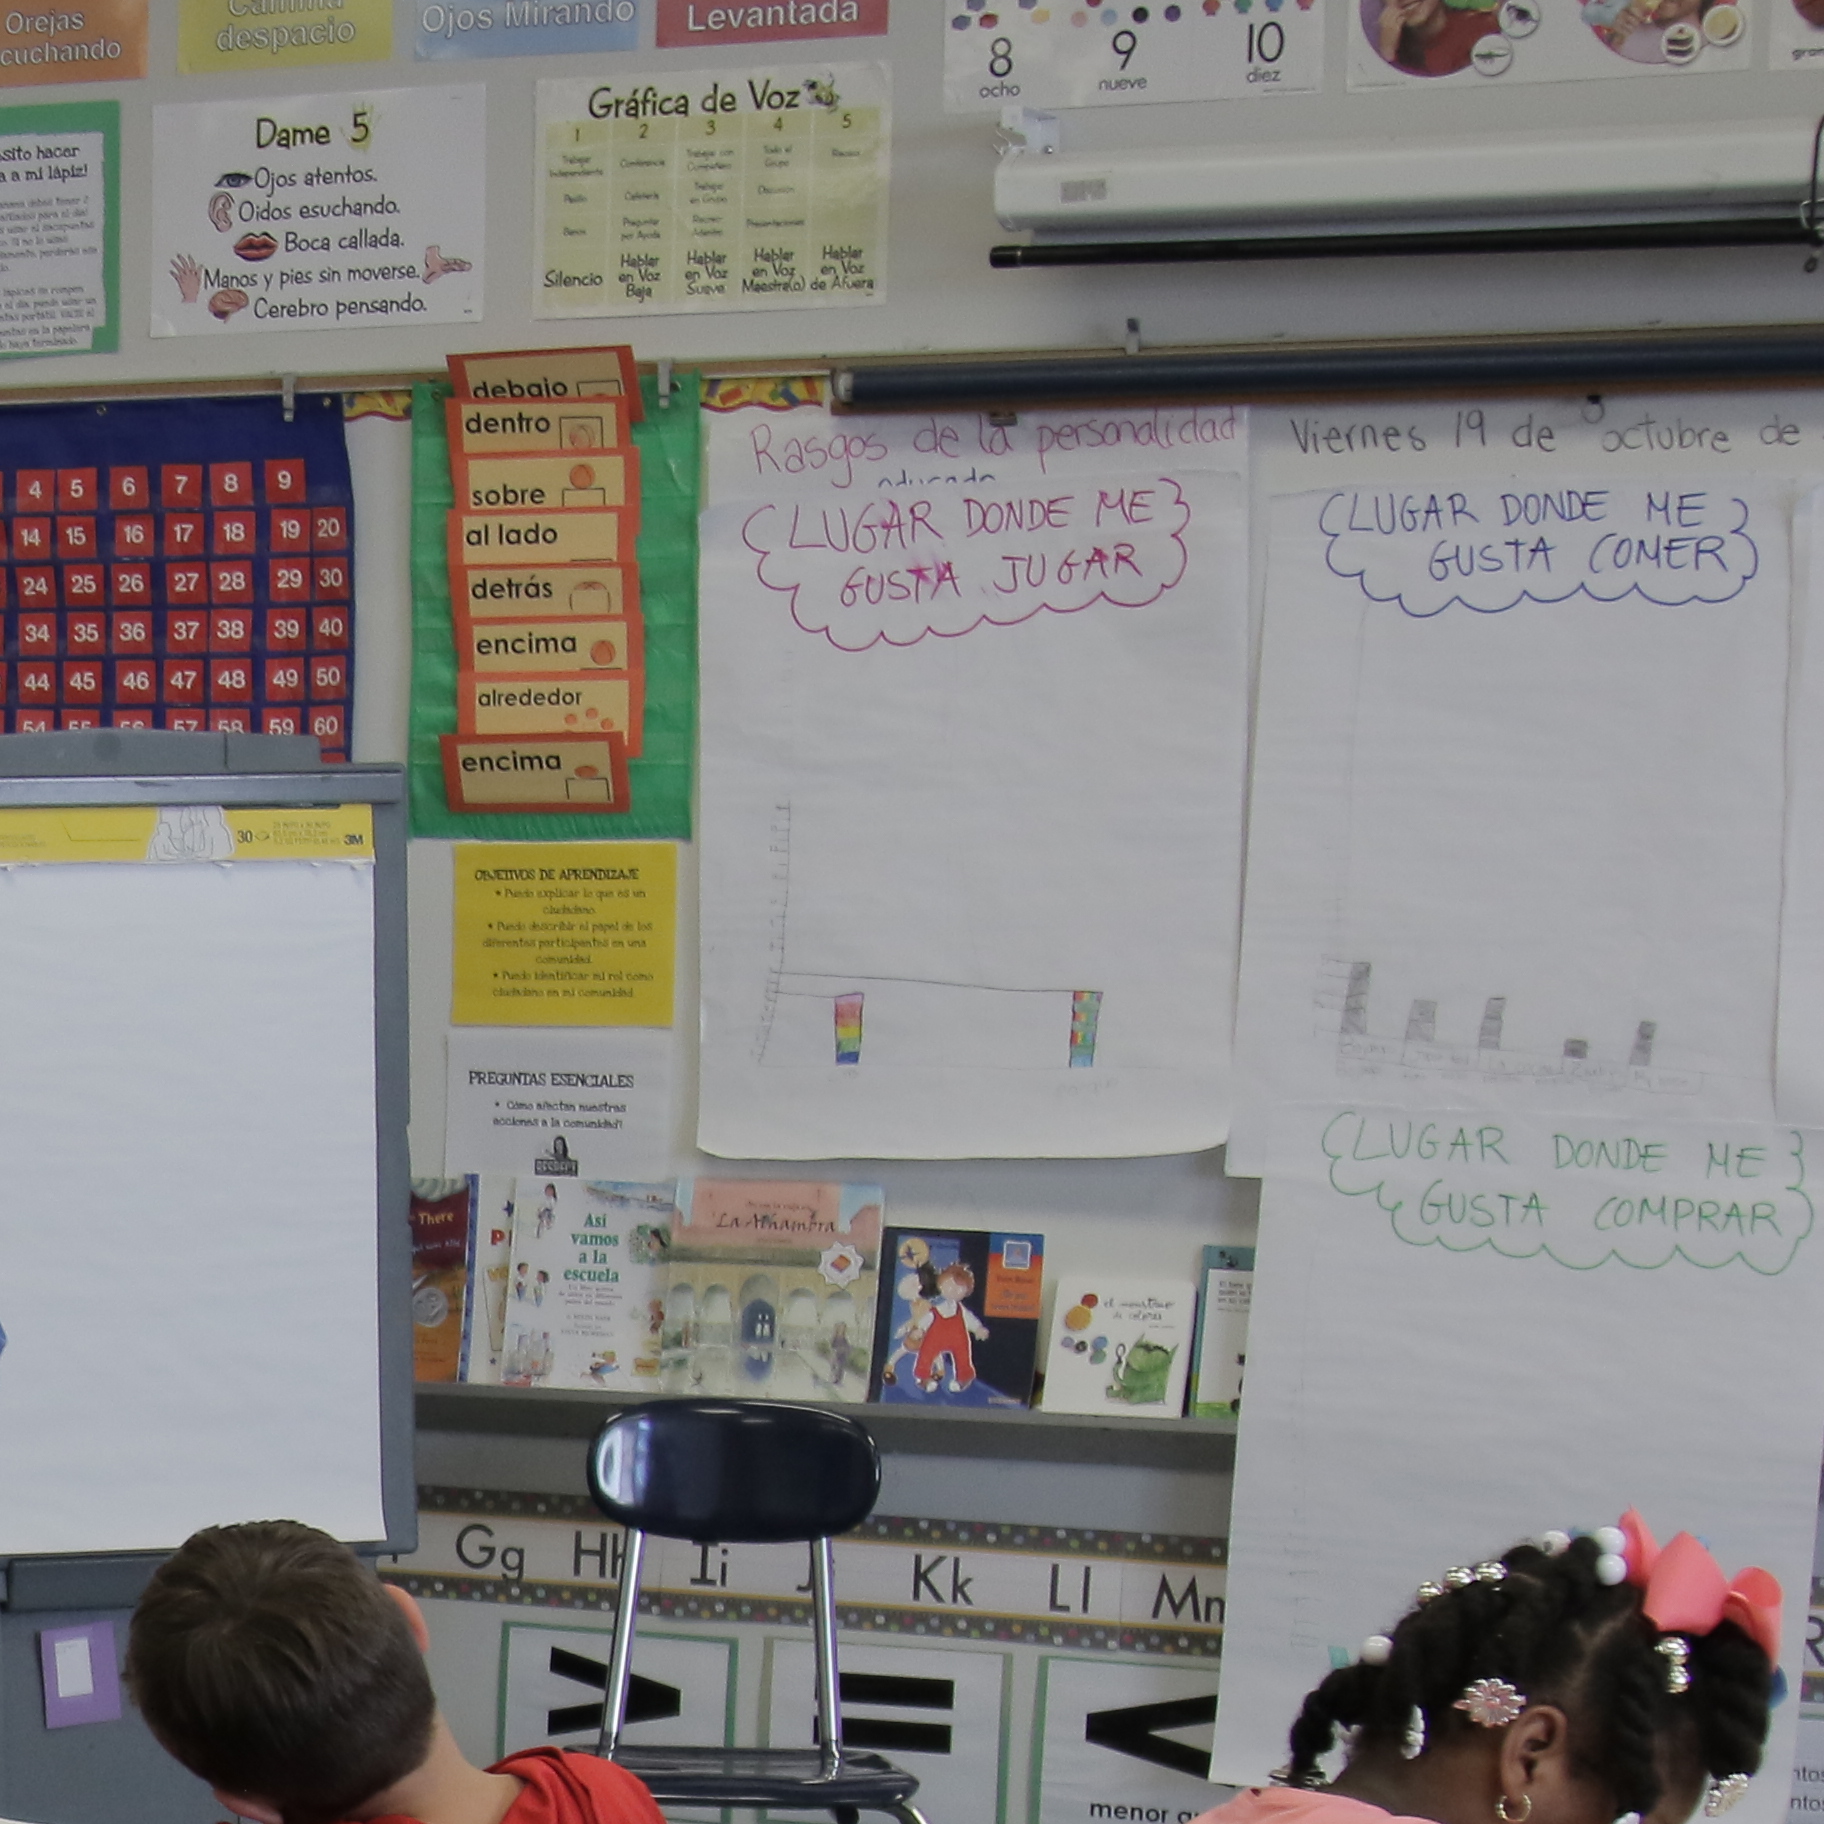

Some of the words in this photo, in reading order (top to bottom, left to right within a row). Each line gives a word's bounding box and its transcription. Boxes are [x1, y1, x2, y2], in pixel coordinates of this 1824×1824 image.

[5, 10, 85, 38] Orejas
[421, 3, 493, 35] Ojos
[504, 0, 635, 29] Mirando
[686, 0, 860, 30] Levantada
[215, 17, 357, 55] despacio
[1248, 21, 1285, 63] 10
[989, 37, 1012, 77] 8
[1113, 30, 1137, 71] 9
[1098, 76, 1147, 91] nueve
[1246, 68, 1281, 83] diez
[588, 86, 690, 119] Gráfica
[701, 83, 737, 113] de
[748, 79, 800, 111] Voz
[979, 82, 1021, 98] ocho
[255, 117, 330, 150] Dame
[37, 145, 80, 160] hacer
[12, 170, 20, 181] a
[254, 167, 297, 197] Ojos
[304, 165, 378, 188] atentos.
[238, 201, 292, 222] Oidos
[299, 194, 400, 218] esuchando.
[285, 232, 330, 252] Boca
[338, 229, 405, 250] callada.
[204, 269, 258, 290] Manos
[264, 271, 273, 290] y
[280, 264, 313, 291] pies
[320, 265, 342, 284] sin
[348, 263, 420, 282] moverse.
[544, 270, 603, 288] Silencio
[254, 297, 329, 319] Cerebro
[336, 292, 427, 319] pensando.
[464, 410, 551, 435] dentro
[1290, 418, 1428, 454] Viernes
[1455, 409, 1485, 448] 19
[1512, 414, 1557, 452] de
[1603, 417, 1732, 453] octubre
[1760, 410, 1800, 447] de
[751, 423, 889, 490] Rasgos
[913, 418, 960, 456] de
[977, 414, 1014, 455] la
[1038, 405, 1237, 474] personalidad
[472, 485, 547, 506] sobre
[789, 500, 944, 554] LUGAR
[966, 496, 1075, 538] DONDE
[1095, 489, 1155, 525] ME
[1348, 494, 1479, 534] LUGAR
[1503, 490, 1609, 527] DONDE
[1646, 491, 1707, 528] ME
[21, 529, 40, 546] 14
[66, 527, 86, 545] 15
[124, 525, 144, 543] 16
[174, 524, 193, 542] 17
[223, 523, 245, 541] 18
[280, 520, 300, 538] 19
[318, 518, 340, 537] 20
[466, 526, 489, 546] al
[498, 522, 558, 546] lado
[1429, 536, 1557, 581] GUSTA
[1590, 533, 1729, 574] COMER
[472, 575, 553, 600] detrás
[840, 561, 962, 609] GUSTA
[994, 543, 1143, 595] JUGAR
[476, 631, 577, 656] encima
[478, 688, 582, 707] alrededor
[461, 749, 563, 773] encima
[237, 830, 252, 843] 30
[344, 834, 363, 846] 3M
[475, 869, 535, 881] OBJETIVOS
[540, 869, 555, 880] DE
[559, 869, 640, 880] APRENDIZAJE
[468, 1071, 546, 1086] PREGUNTAS
[551, 1074, 634, 1088] ESENCIALES
[1354, 1116, 1510, 1165] LUGAR
[1553, 1133, 1669, 1174] DONDE
[1706, 1141, 1767, 1178] ME
[584, 1213, 607, 1228] Así
[1420, 1179, 1549, 1227] GUSTA
[1595, 1196, 1782, 1237] COMPRAR
[571, 1233, 619, 1246] vamos
[579, 1252, 587, 1263] a
[593, 1250, 607, 1264] la
[563, 1269, 619, 1283] escuela
[456, 1524, 525, 1583] Gg
[912, 1554, 974, 1606] Kk
[1090, 1803, 1169, 1823] menor
